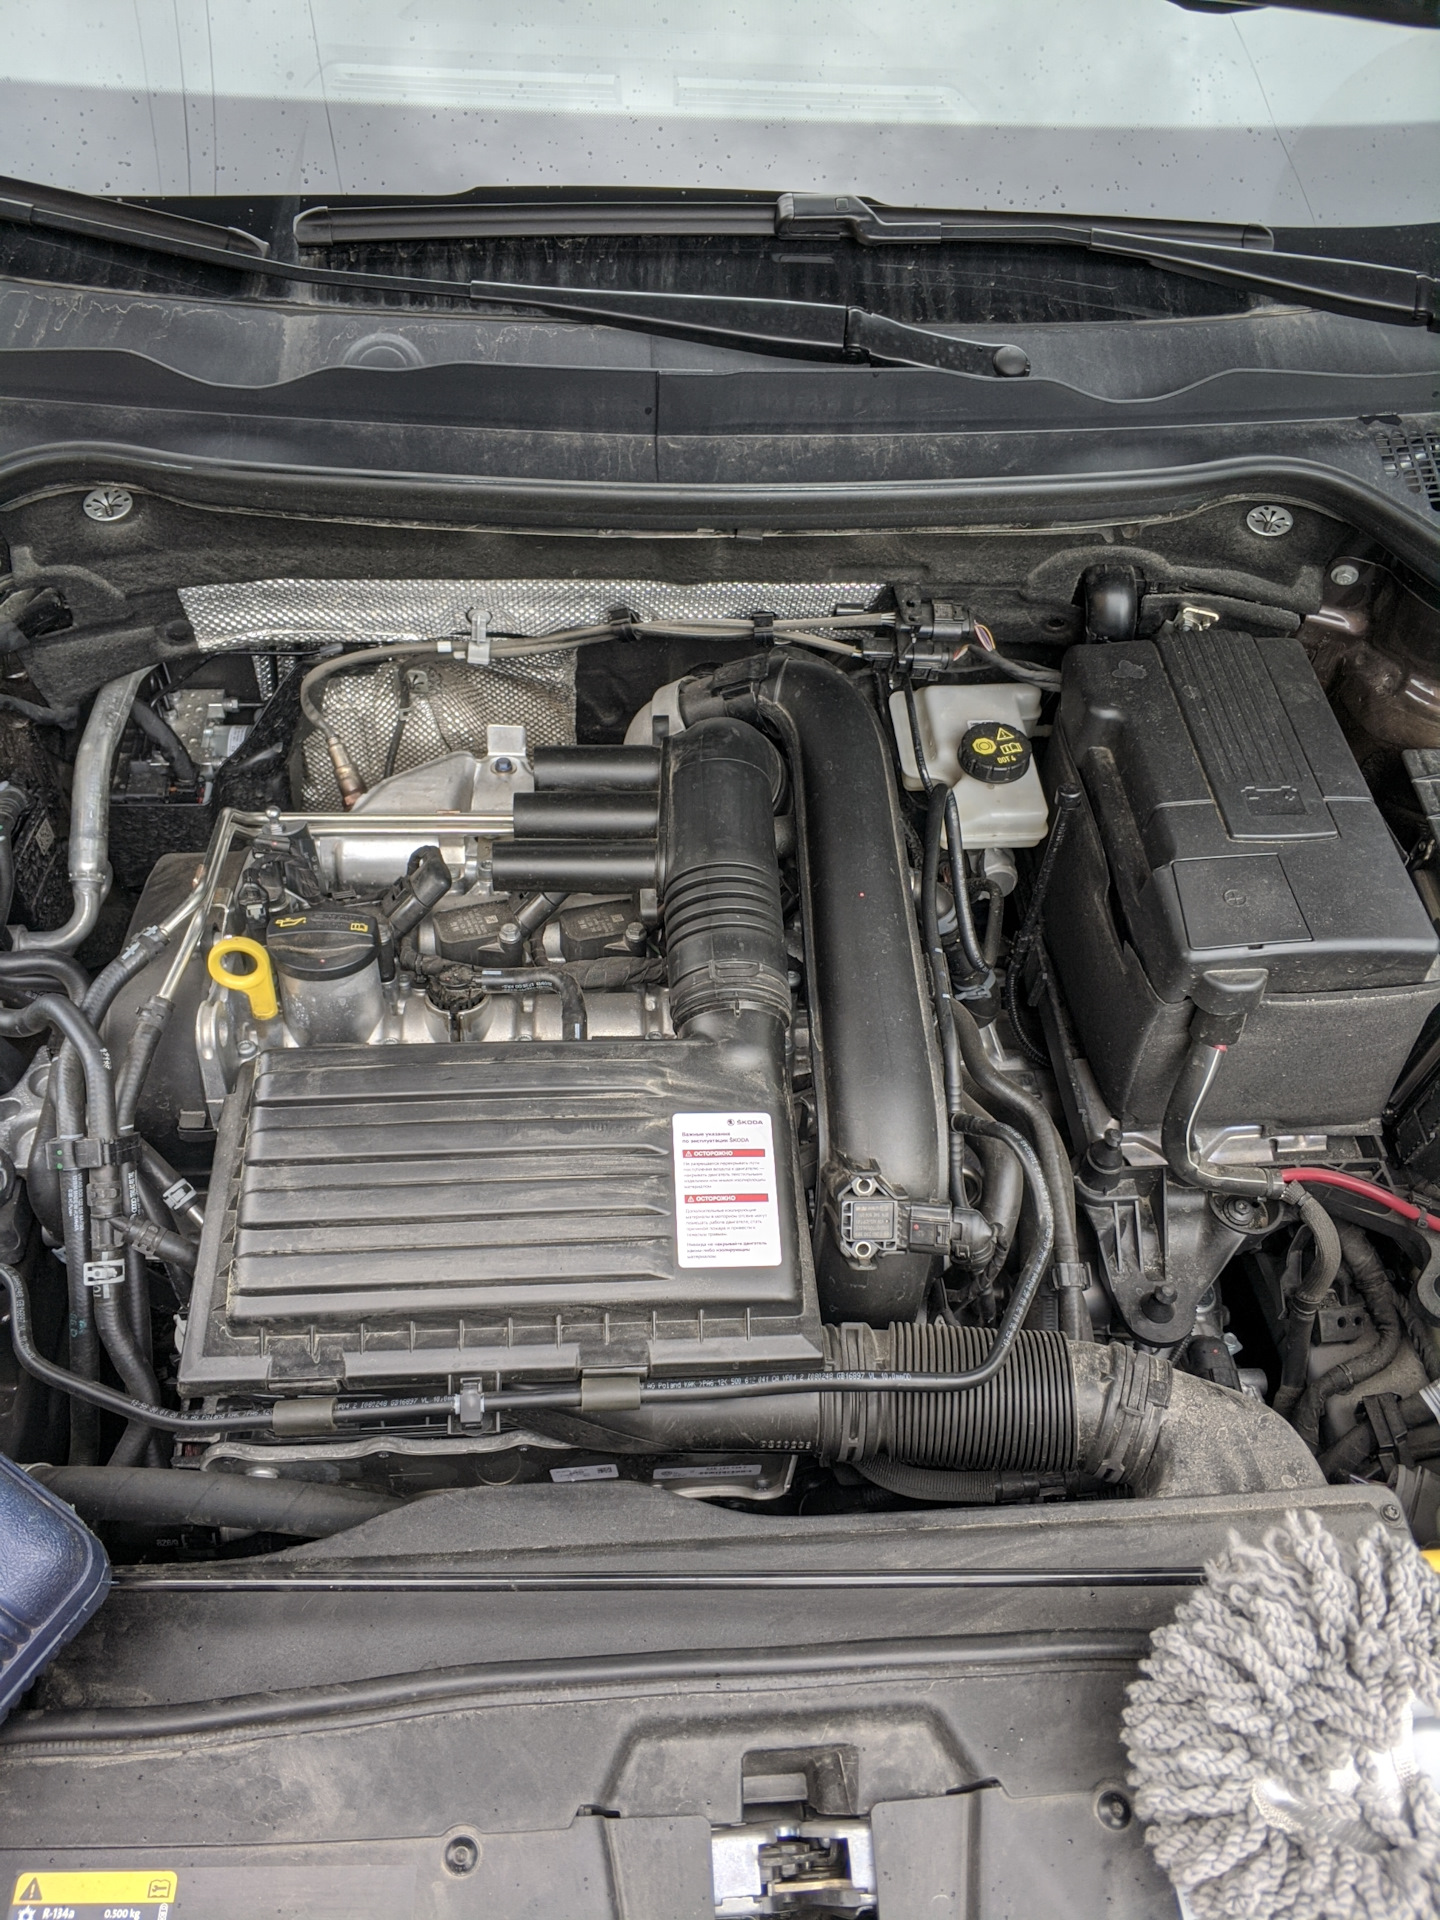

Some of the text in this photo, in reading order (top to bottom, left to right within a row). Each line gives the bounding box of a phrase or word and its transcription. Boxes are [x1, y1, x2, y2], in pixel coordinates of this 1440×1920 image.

[996, 756, 1010, 764] DOT
[658, 1381, 681, 1389] Poland
[836, 1372, 865, 1380] GB16897
[201, 1413, 225, 1421] Poland
[42, 1907, 141, 1920] R-134a 0.500 kg
